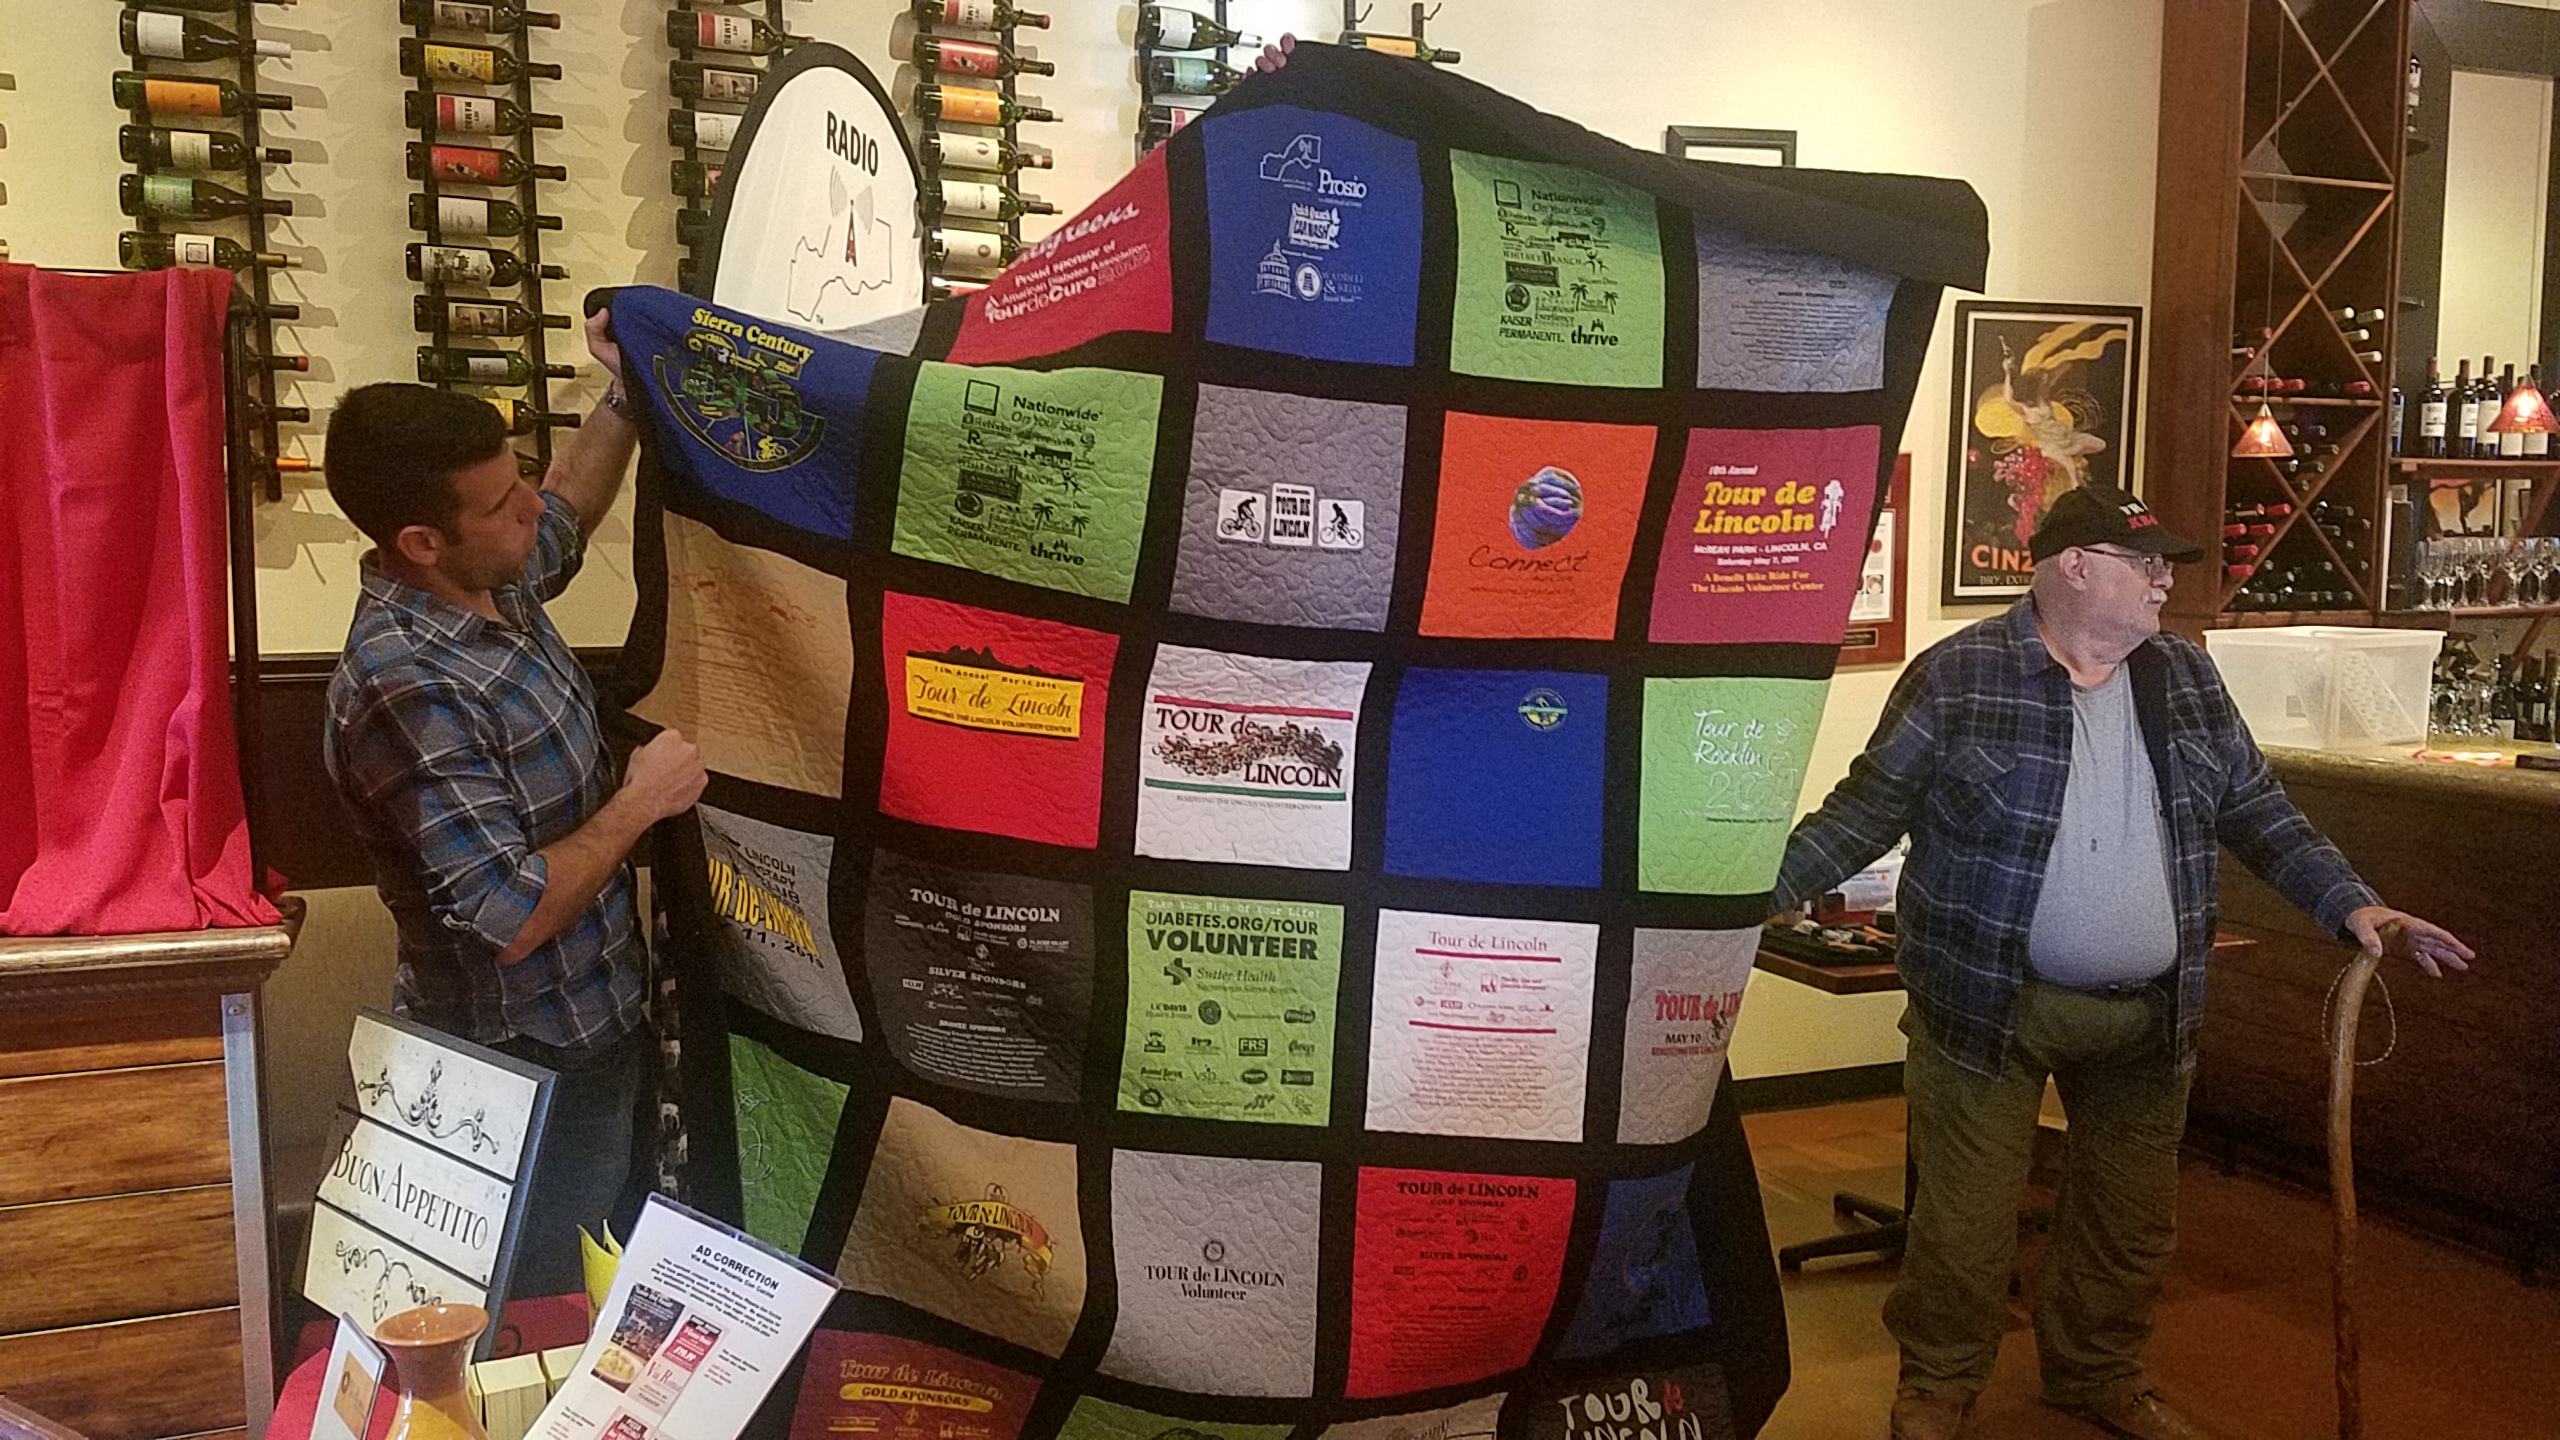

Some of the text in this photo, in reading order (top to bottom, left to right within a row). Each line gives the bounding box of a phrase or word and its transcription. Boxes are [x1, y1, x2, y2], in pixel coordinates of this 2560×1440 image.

[826, 110, 879, 177] RADIO
[1317, 168, 1368, 199] Prosio
[1015, 240, 1116, 287] Proud sponsor of
[1001, 282, 1047, 305] American
[1501, 314, 1532, 327] KAISER
[691, 307, 744, 338] Sierra
[746, 325, 814, 364] Century
[1570, 324, 1619, 346] thrive
[1013, 395, 1101, 422] Nationwide
[1703, 480, 1817, 506] Tour de
[1693, 508, 1815, 535] Lincoln
[1030, 542, 1085, 566] thrive
[1468, 544, 1590, 573] Connect
[1813, 541, 1828, 551] CA
[1971, 543, 2036, 573] CINZ
[913, 674, 1072, 719] Tour de Lincoln
[1044, 724, 1073, 734] CENTER
[1156, 707, 1258, 736] TOUR de
[1694, 709, 1765, 740] Tour de
[1693, 739, 1762, 767] Rocklin
[1243, 762, 1343, 789] LINCOLN
[744, 846, 796, 877] LINCOLN
[909, 887, 1061, 924] TOUR de LINCOLN
[973, 919, 1027, 933] SPONSORS
[1145, 911, 1319, 936] DIABETES.ORG/TOUR
[1146, 928, 1319, 961] VOLUNTEER
[1428, 930, 1548, 951] Tour de Lincoln
[928, 965, 1027, 990] SILVER SPONSORS
[1196, 967, 1277, 983] Sutter Health
[1655, 993, 1702, 1022] TOUR
[1239, 1038, 1267, 1050] FRS
[1665, 1033, 1702, 1045] MAY 10
[332, 1134, 488, 1250] BUON APPETITO
[1397, 1181, 1539, 1199] TOUR de LINCOLN
[695, 1244, 780, 1291] AD CORRECTION
[1143, 1265, 1286, 1288] TOUR de LINCOLN
[1180, 1282, 1247, 1301] Volunteer
[840, 1358, 1004, 1400] Tour de Lincoln
[862, 1385, 971, 1408] GOLD SPONSORS
[1558, 1378, 1662, 1431] TOUR
